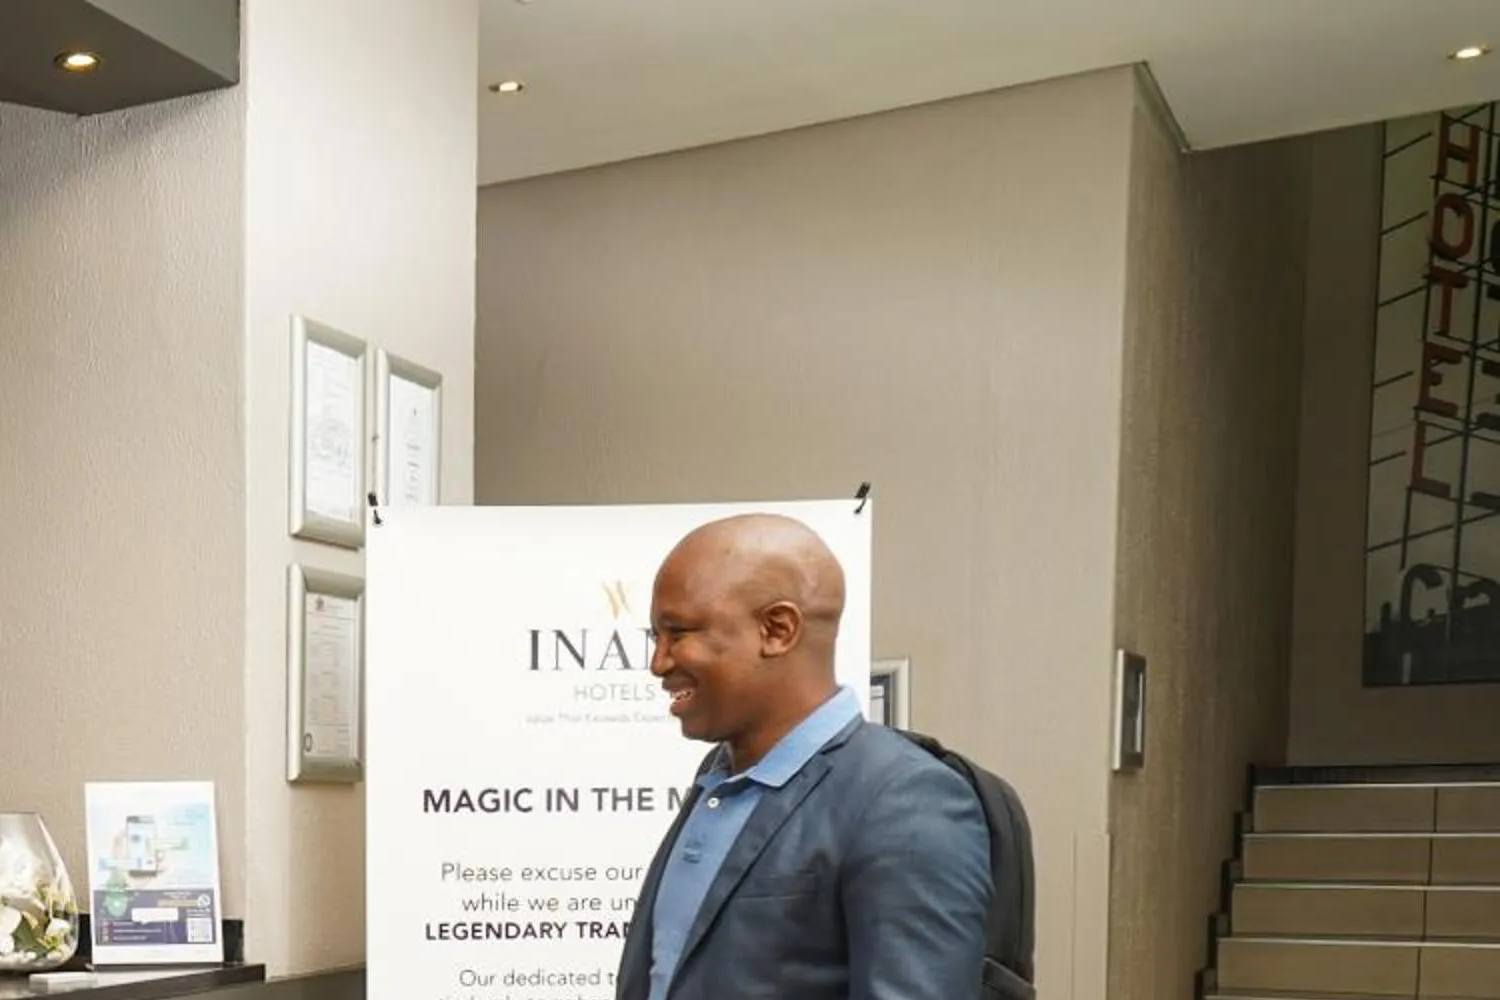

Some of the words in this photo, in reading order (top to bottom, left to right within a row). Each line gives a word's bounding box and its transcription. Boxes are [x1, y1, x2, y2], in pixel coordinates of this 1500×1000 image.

[1410, 114, 1481, 499] HOTEL
[529, 628, 657, 671] INA
[574, 683, 656, 701] HOTELS
[423, 787, 533, 813] MAGIC
[546, 787, 579, 812] IN
[591, 787, 654, 811] THE
[668, 787, 692, 811] M
[441, 862, 513, 882] Please
[521, 866, 597, 881] excuse
[605, 865, 643, 881] our
[461, 893, 519, 912] while
[527, 898, 559, 911] we
[567, 897, 602, 911] are
[610, 897, 637, 911] un
[425, 921, 568, 941] LEGENDARY
[576, 921, 633, 939] TRA
[459, 969, 495, 987] Our
[503, 968, 601, 987] dedicated
